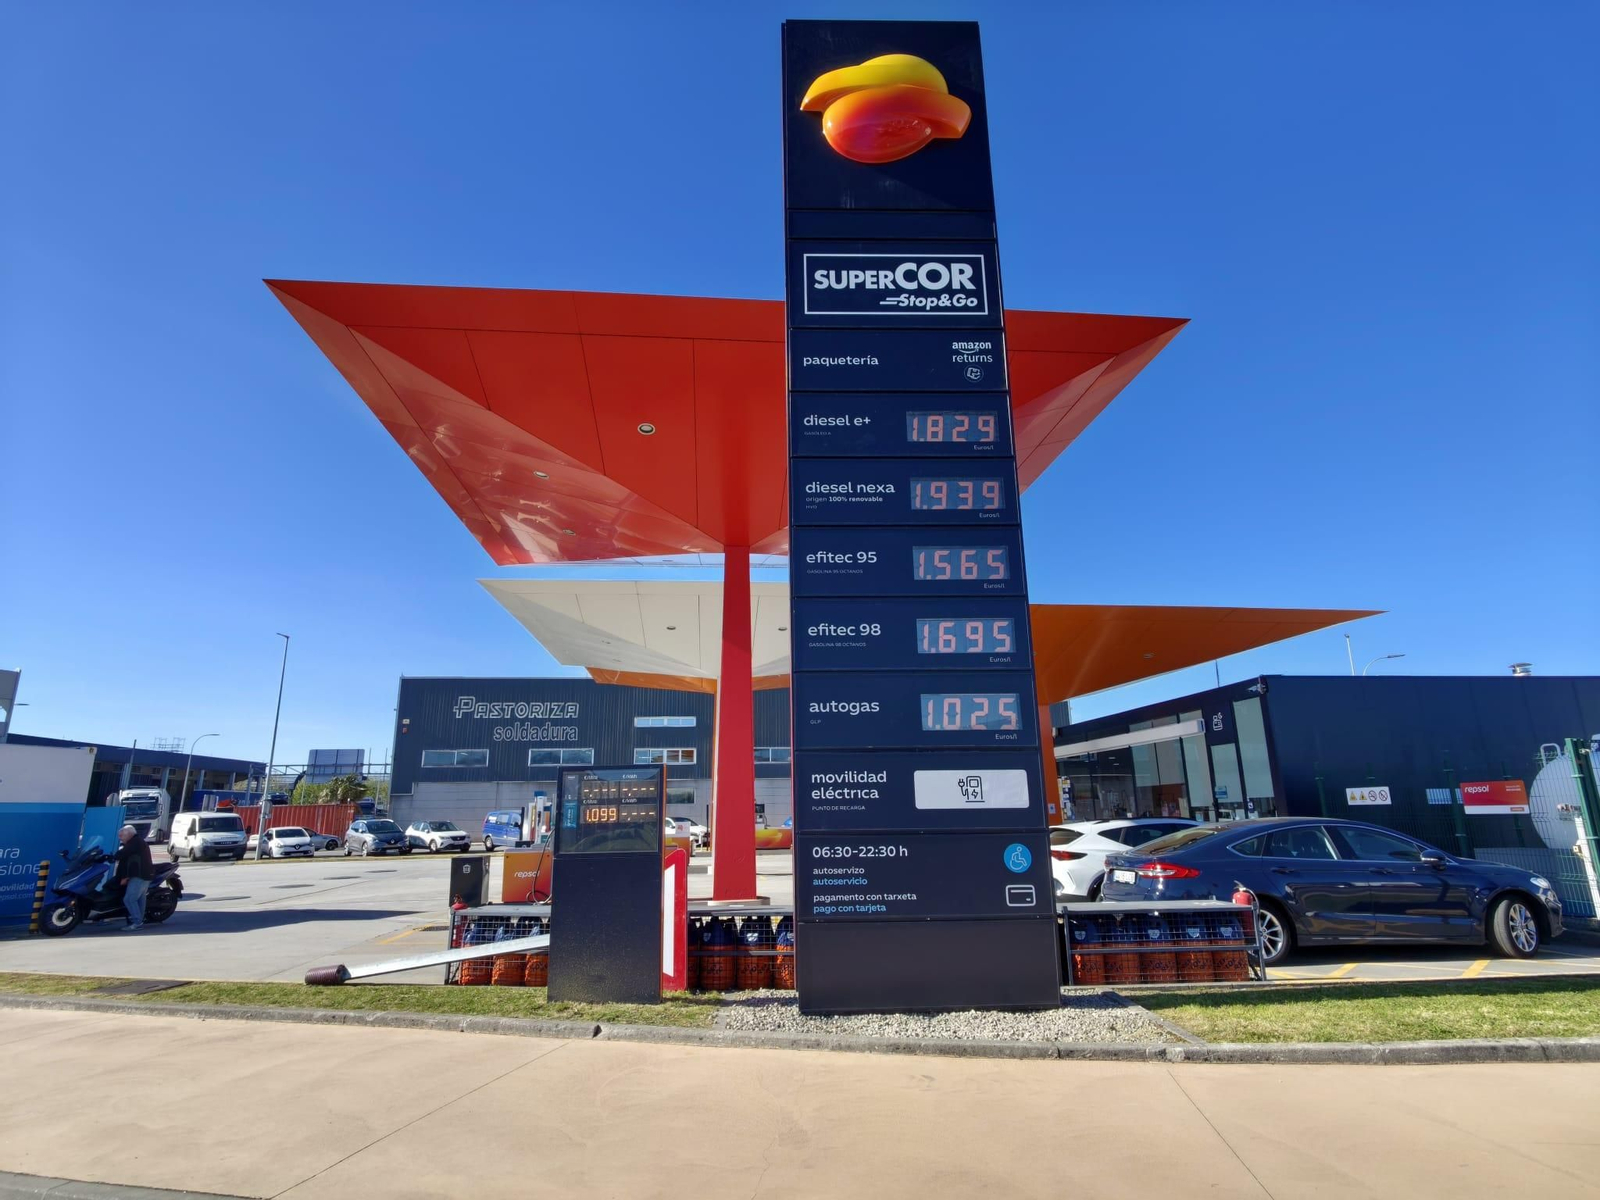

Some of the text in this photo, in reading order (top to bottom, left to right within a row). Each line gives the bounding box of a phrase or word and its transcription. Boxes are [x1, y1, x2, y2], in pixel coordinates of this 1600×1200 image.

[813, 262, 977, 291] SUPERCOR
[898, 293, 978, 310] Stop&Go
[952, 341, 992, 351] amazon
[803, 354, 879, 367] paquetería
[952, 352, 993, 363] returns
[803, 414, 871, 426] diesel e+
[912, 415, 995, 442] 1.829
[805, 481, 896, 494] diesel nexa
[805, 495, 883, 503] origen 100% renovable
[915, 481, 1000, 510] 1.939
[806, 551, 877, 564] efitec 95
[918, 550, 1006, 580] 1.565
[807, 623, 881, 636] efitec 98
[922, 621, 1011, 653] 1.695
[453, 696, 580, 719] PASTORIZA
[809, 700, 880, 715] autogas
[927, 697, 1016, 731] 1.025
[493, 722, 579, 742] soldadura
[811, 770, 887, 784] movilidad
[811, 786, 879, 800] eléctrica
[1464, 784, 1490, 794] repsol
[586, 808, 617, 822] 1.099
[812, 846, 908, 858] 06:30-22:30 h
[812, 866, 865, 875] autoservizo
[0, 882, 35, 892] ovilidad
[812, 876, 868, 886] autoservicio
[813, 893, 865, 903] pagamento
[884, 892, 917, 901] tarxeta
[813, 905, 837, 915] pago
[856, 904, 887, 914] tarjeta
